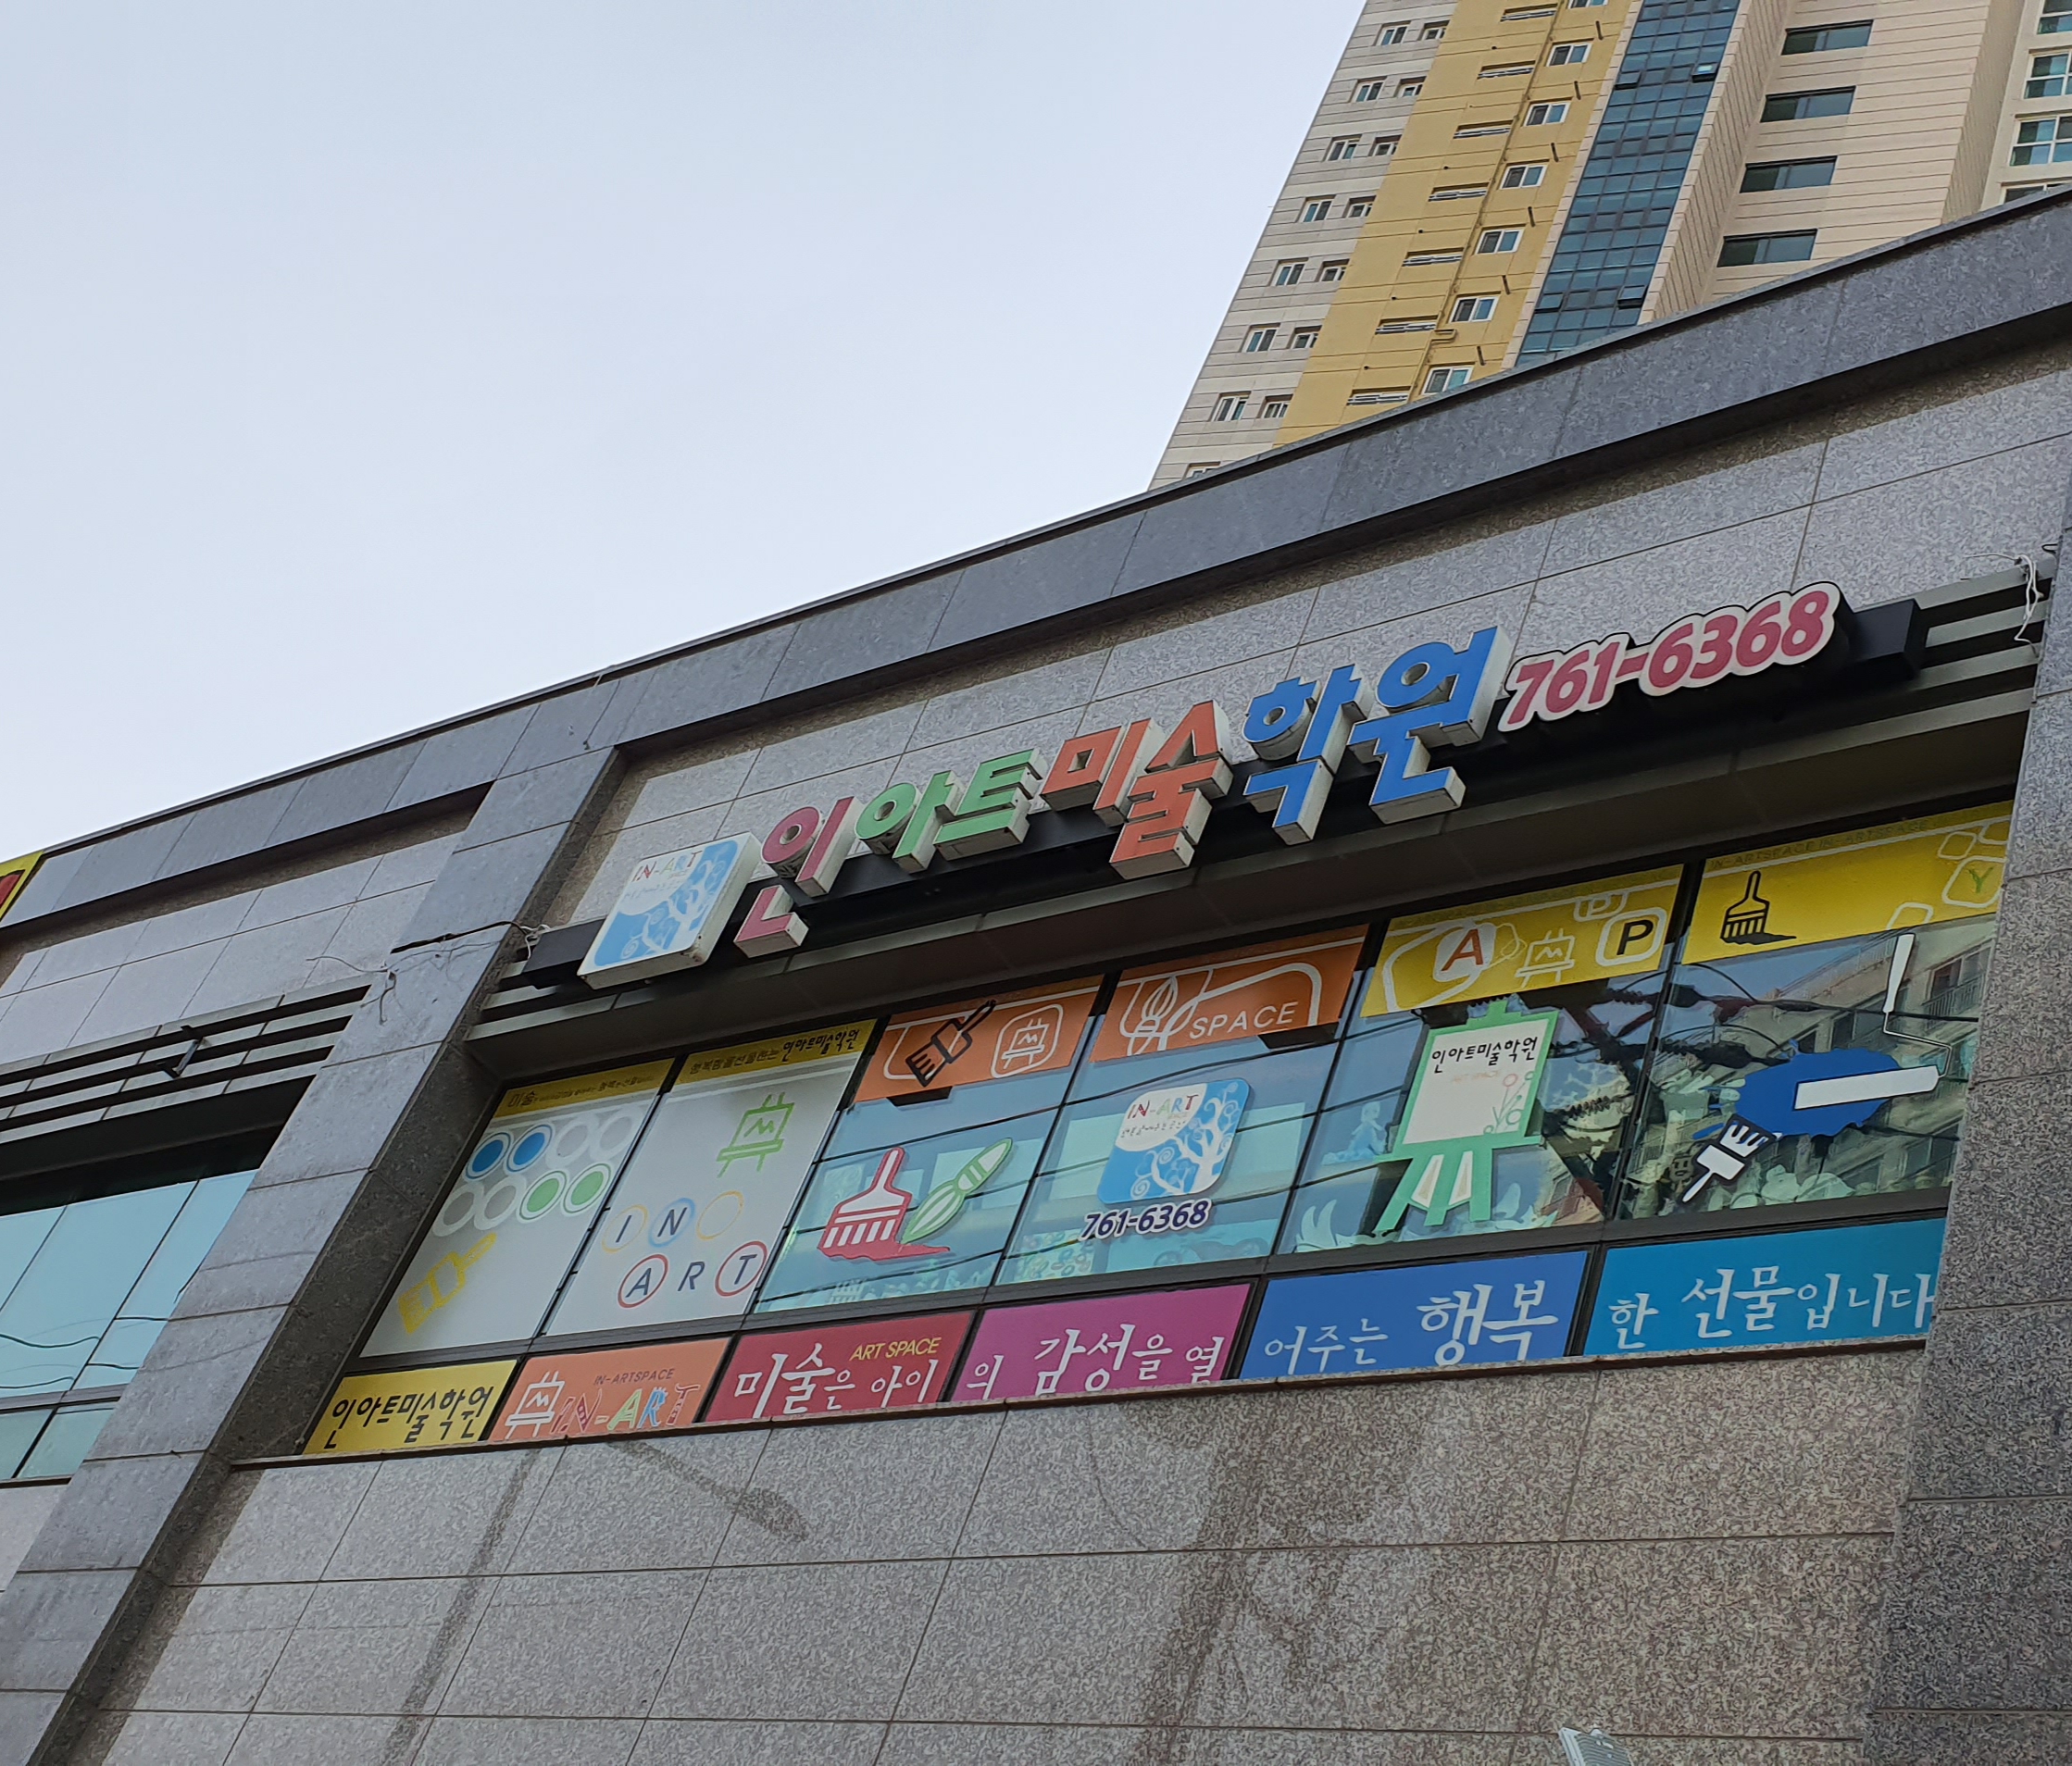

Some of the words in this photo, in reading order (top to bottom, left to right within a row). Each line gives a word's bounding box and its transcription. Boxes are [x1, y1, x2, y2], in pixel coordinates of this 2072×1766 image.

[1504, 587, 1835, 728] 761-6368
[1441, 928, 1484, 972] A
[1616, 919, 1654, 956] P
[1189, 1001, 1298, 1040] SPACE
[1431, 1036, 1539, 1075] 인아트미술학원
[1127, 1093, 1200, 1120] IN-ART
[1080, 1200, 1211, 1240] 761-6368
[733, 1342, 856, 1420] 미술은
[1033, 1323, 1174, 1397] 감성을
[1680, 1264, 1937, 1340] 선물입니다
[848, 1341, 886, 1362] ART
[884, 1337, 942, 1360] SPACE
[593, 1367, 676, 1387] IN-ARTSPACE
[323, 1386, 494, 1450] 인아트미술학원
[550, 1383, 702, 1436] IN-ART
